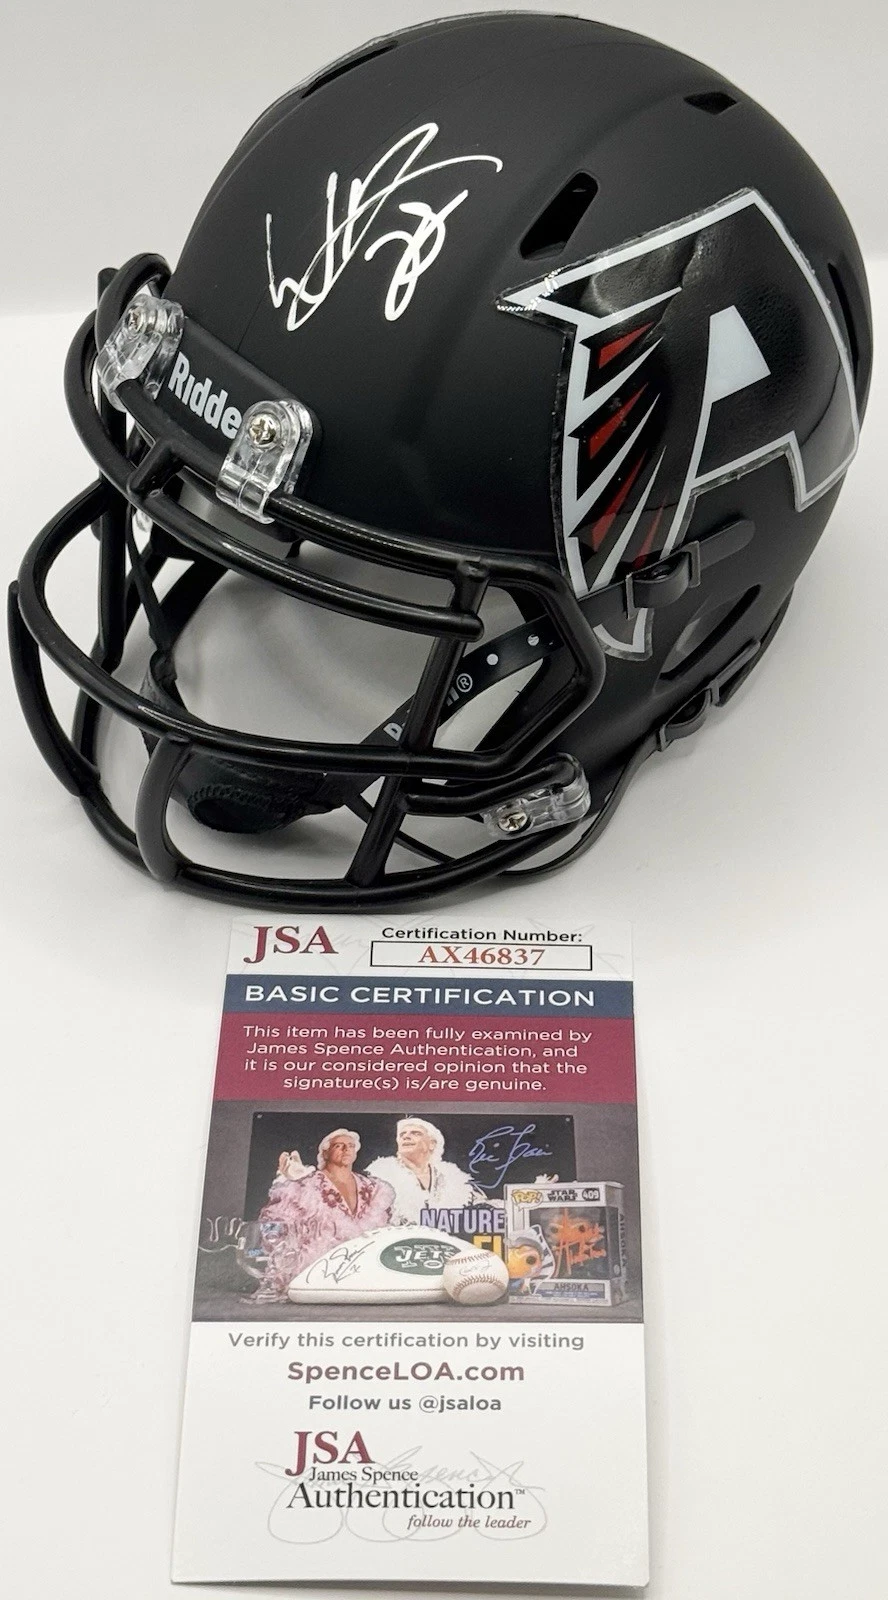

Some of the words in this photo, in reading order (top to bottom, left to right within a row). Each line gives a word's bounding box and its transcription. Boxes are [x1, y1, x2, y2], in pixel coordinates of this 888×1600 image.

[168, 351, 243, 440] Ridde
[242, 925, 340, 964] JSA
[381, 927, 497, 942] Certification
[503, 929, 582, 943] Number:
[419, 946, 546, 965] AX46837
[245, 985, 340, 1003] BASIC
[350, 986, 594, 1007] CERTIFICATION
[243, 1025, 280, 1038] This
[286, 1025, 328, 1038] item
[334, 1026, 367, 1039] has
[372, 1026, 419, 1039] been
[425, 1026, 466, 1042] fully
[471, 1028, 563, 1041] examined
[569, 1029, 593, 1044] by
[246, 1042, 308, 1055] James
[313, 1042, 385, 1057] Spence
[389, 1043, 537, 1059] Authentication,
[542, 1045, 578, 1058] and
[244, 1058, 258, 1071] it
[263, 1058, 278, 1071] is
[283, 1061, 317, 1071] our
[321, 1059, 428, 1073] considered
[434, 1060, 506, 1075] opinion
[511, 1061, 550, 1074] that
[556, 1061, 588, 1075] the
[283, 1075, 400, 1091] signature(s)
[406, 1075, 460, 1091] is/are
[465, 1077, 547, 1092] genuine.
[551, 1188, 577, 1196] STAR
[583, 1190, 600, 1200] 409
[421, 1208, 505, 1234] NATURE
[553, 1282, 589, 1291] AHSOKA
[228, 1332, 291, 1350] Verify
[297, 1332, 335, 1347] this
[341, 1332, 469, 1348] certification
[475, 1332, 502, 1351] by
[508, 1332, 584, 1351] visiting
[287, 1361, 525, 1385] SpenceLOA.com
[308, 1394, 382, 1411] Follow
[388, 1398, 412, 1411] us
[418, 1394, 502, 1414] @jsaloa
[284, 1430, 376, 1478] JSA
[308, 1466, 357, 1482] James
[361, 1466, 419, 1485] Spence
[406, 1514, 453, 1530] follow
[457, 1514, 481, 1528] the
[484, 1515, 532, 1529] leader
